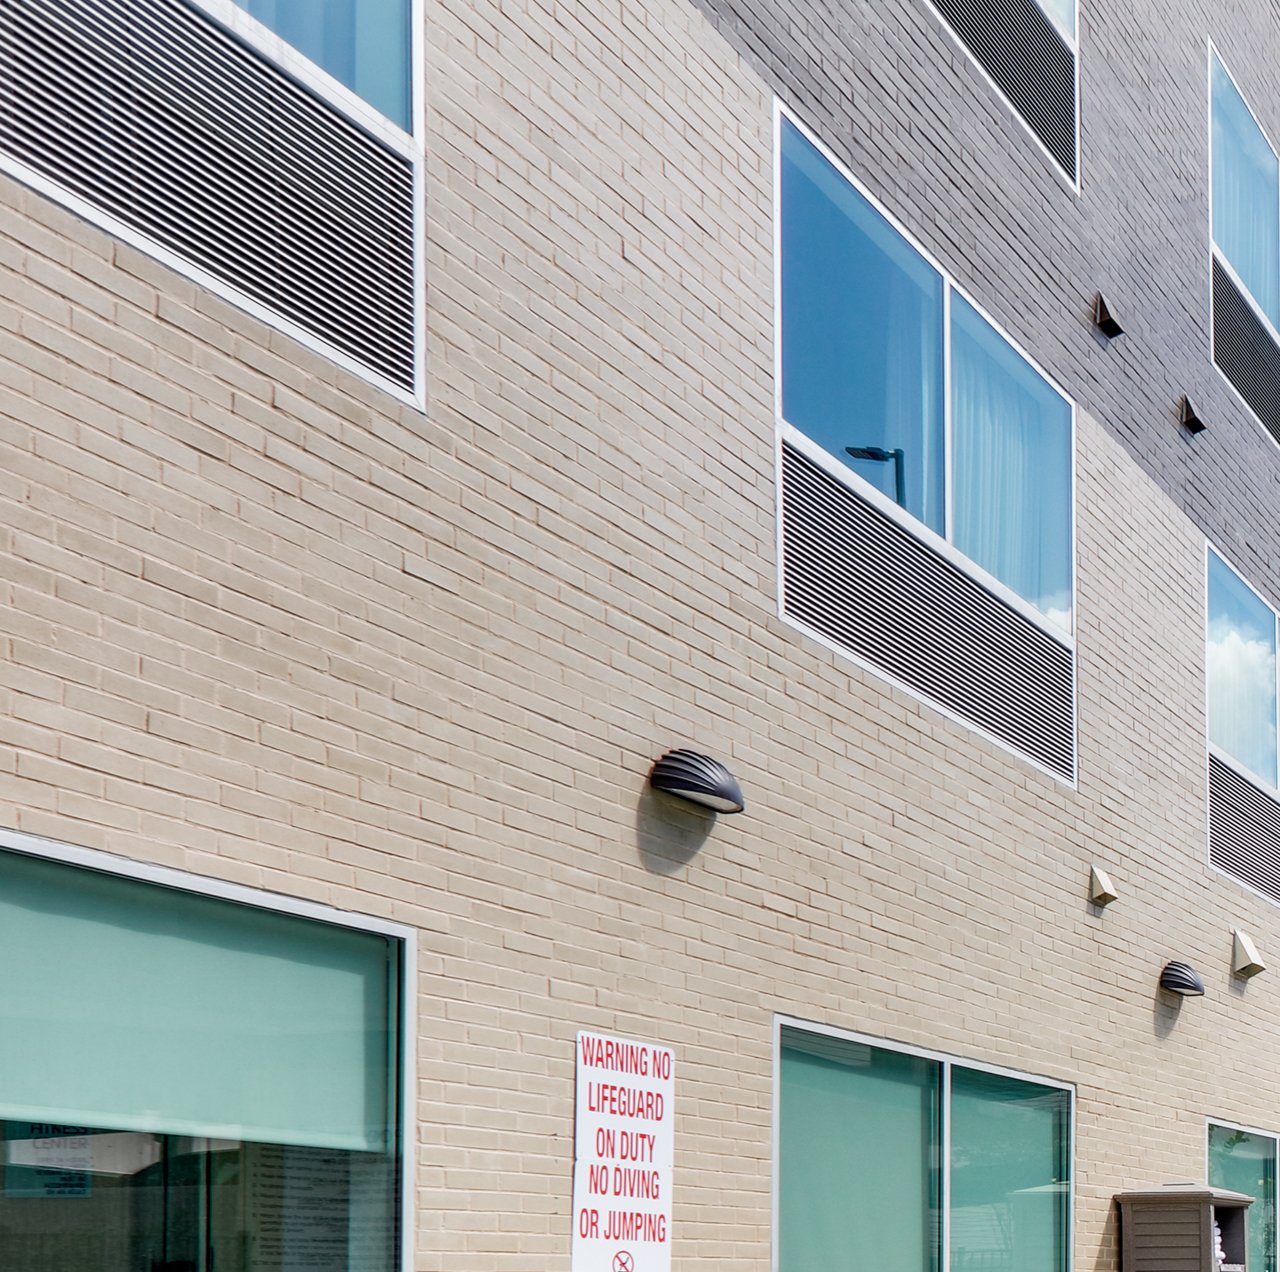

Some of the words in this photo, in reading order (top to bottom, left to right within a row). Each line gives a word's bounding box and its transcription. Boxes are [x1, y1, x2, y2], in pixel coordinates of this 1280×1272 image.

[581, 1036, 648, 1076] WARNING
[653, 1049, 671, 1081] NO
[588, 1081, 664, 1121] LIFEGUARD
[596, 1127, 615, 1159] ON
[620, 1130, 656, 1163] DUTY
[589, 1164, 609, 1195] NO
[613, 1166, 660, 1199] DIVING
[579, 1208, 599, 1239] OR
[603, 1210, 666, 1243] JUMPING
